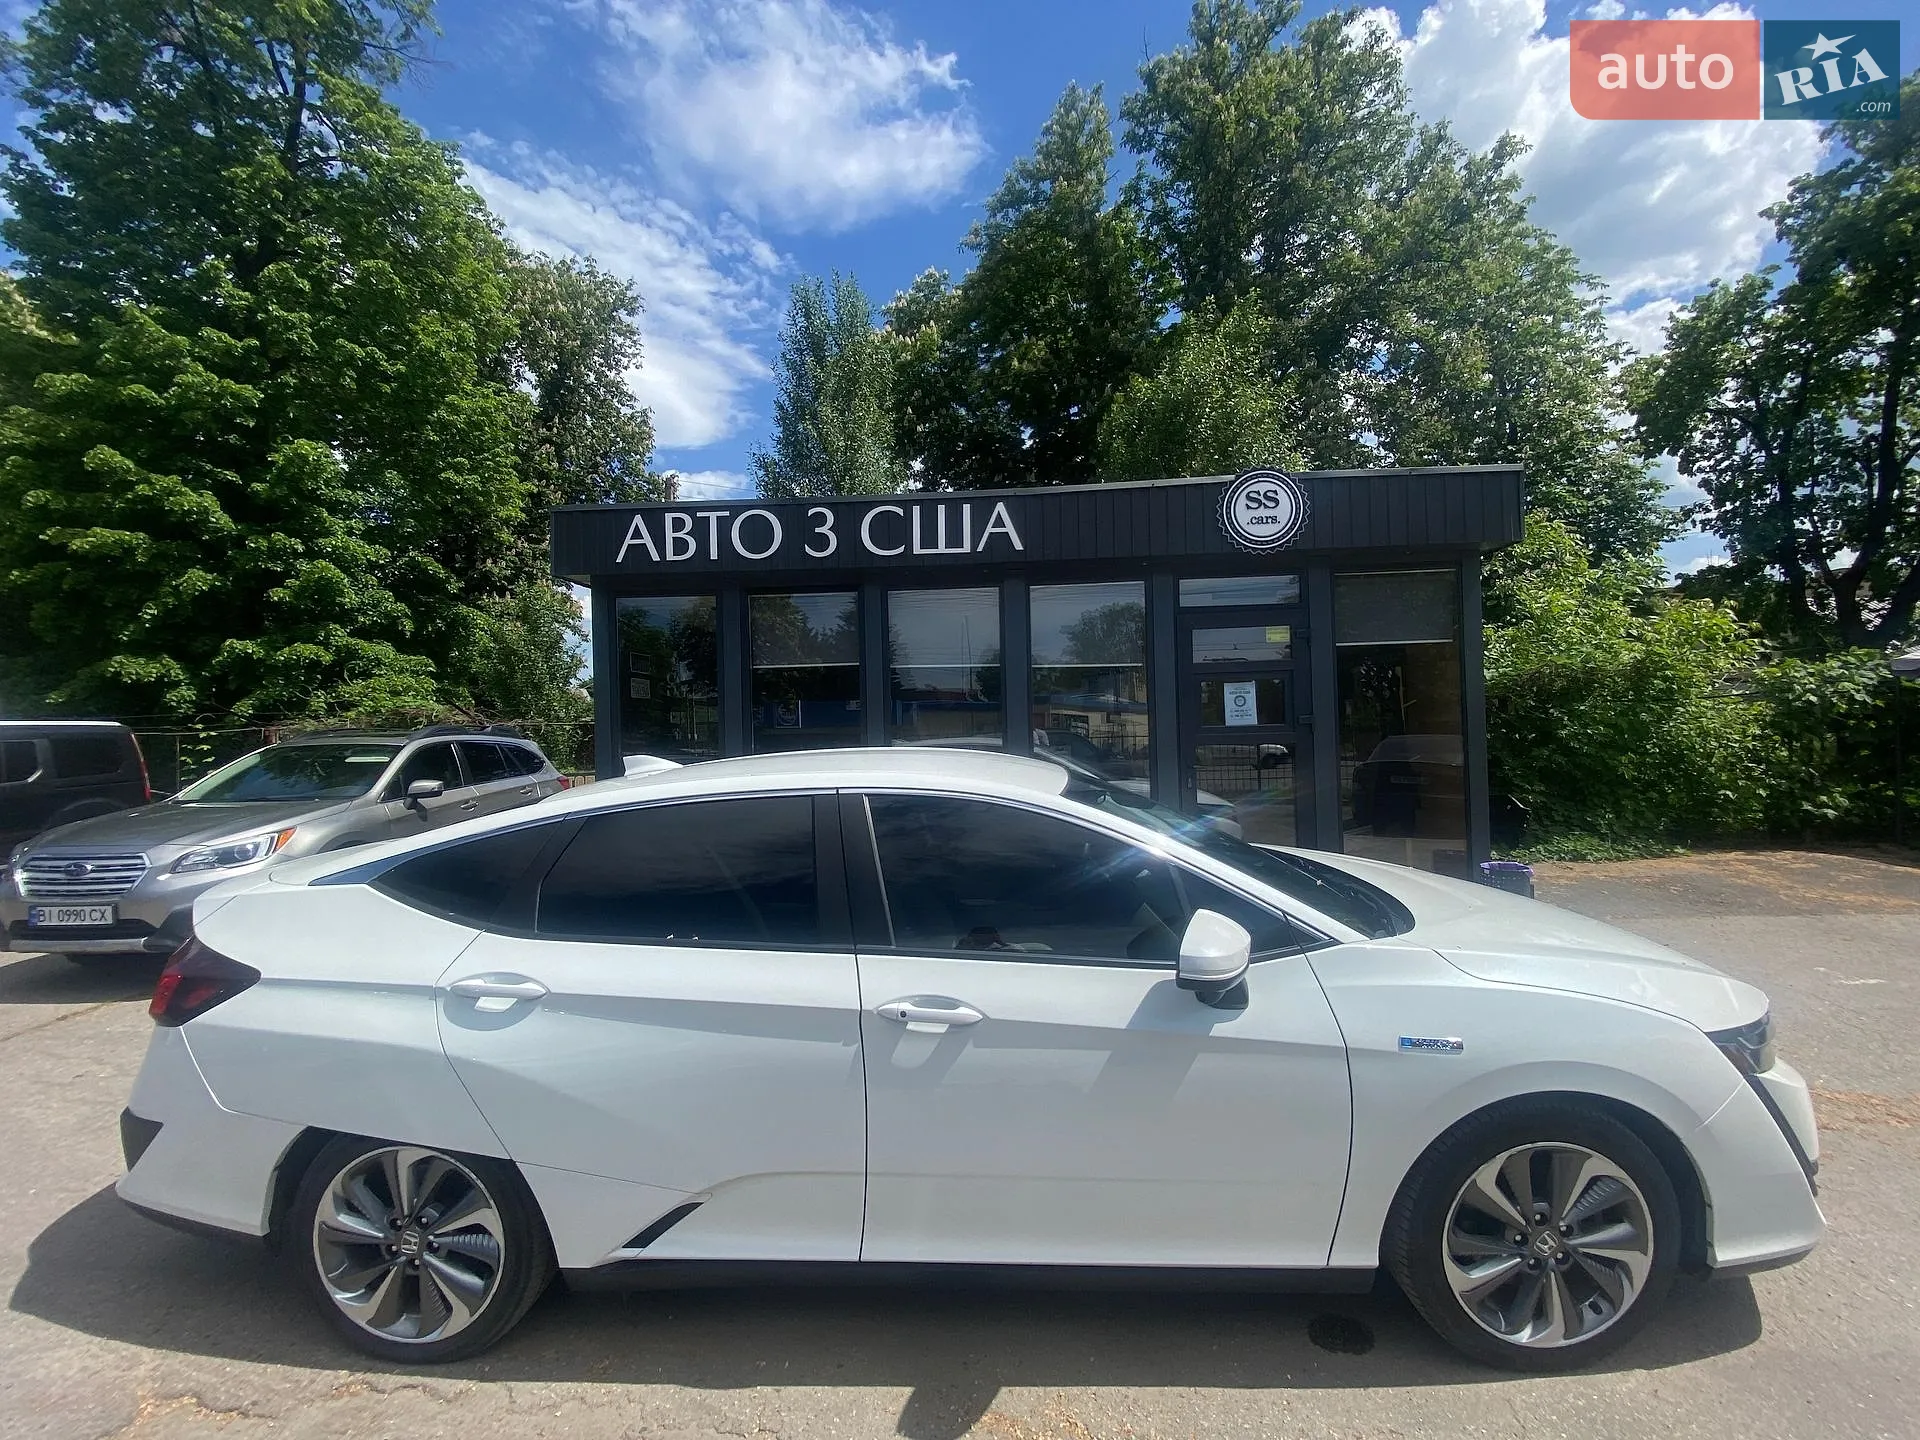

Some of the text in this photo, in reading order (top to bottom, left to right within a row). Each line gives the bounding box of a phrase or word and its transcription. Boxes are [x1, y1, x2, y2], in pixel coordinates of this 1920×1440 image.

[1245, 489, 1280, 510] SS
[615, 509, 783, 563] АВТО
[860, 501, 1025, 556] США
[57, 909, 86, 922] 0990
[89, 909, 107, 921] CX
